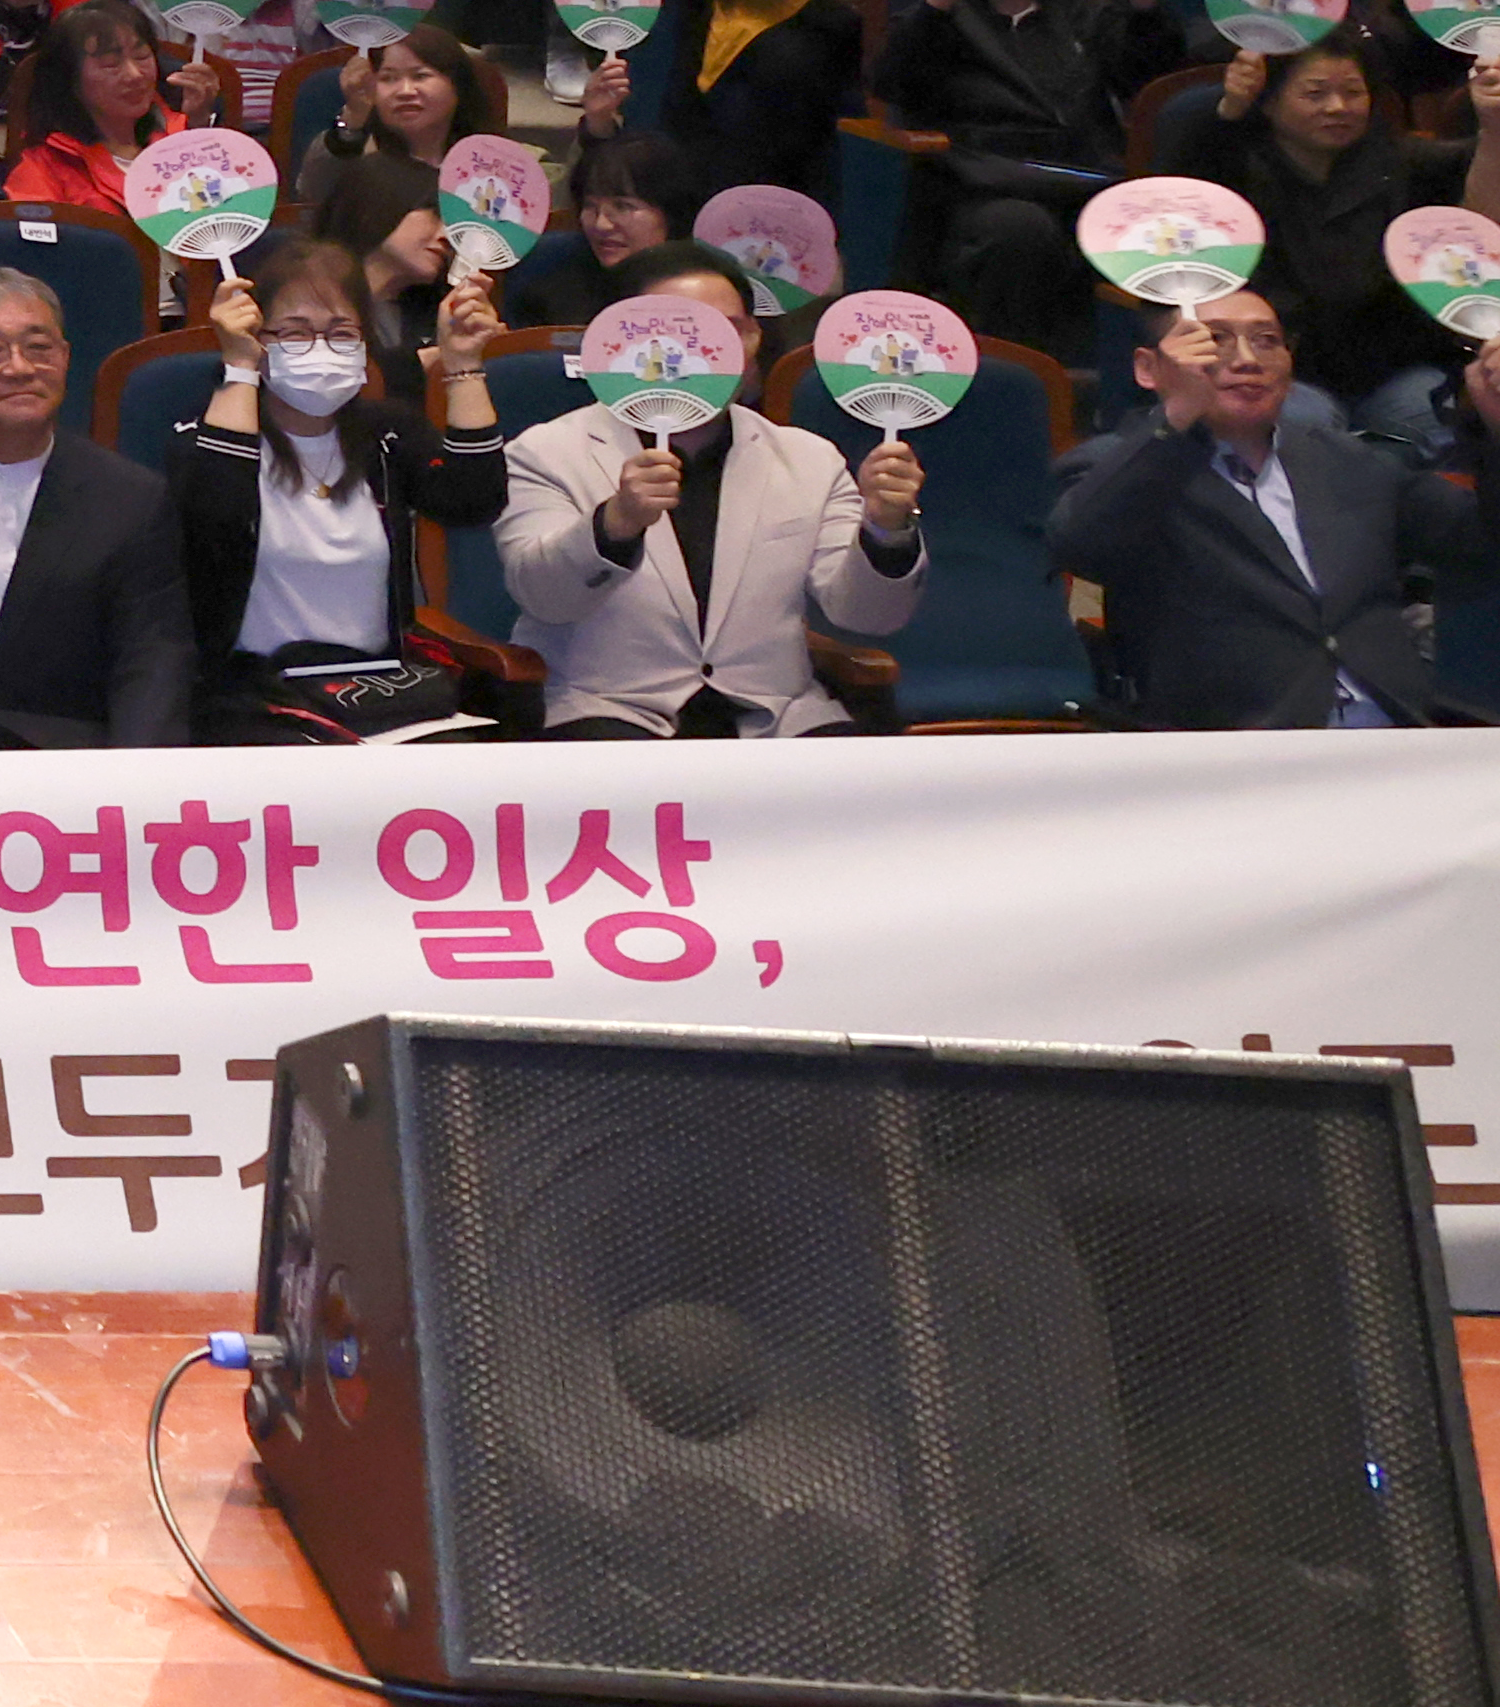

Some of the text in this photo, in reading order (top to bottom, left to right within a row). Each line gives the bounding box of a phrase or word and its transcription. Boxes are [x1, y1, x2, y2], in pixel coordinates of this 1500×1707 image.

[152, 147, 231, 179] 장애인의 날
[913, 321, 934, 346] 날
[376, 802, 785, 988] 일상,
